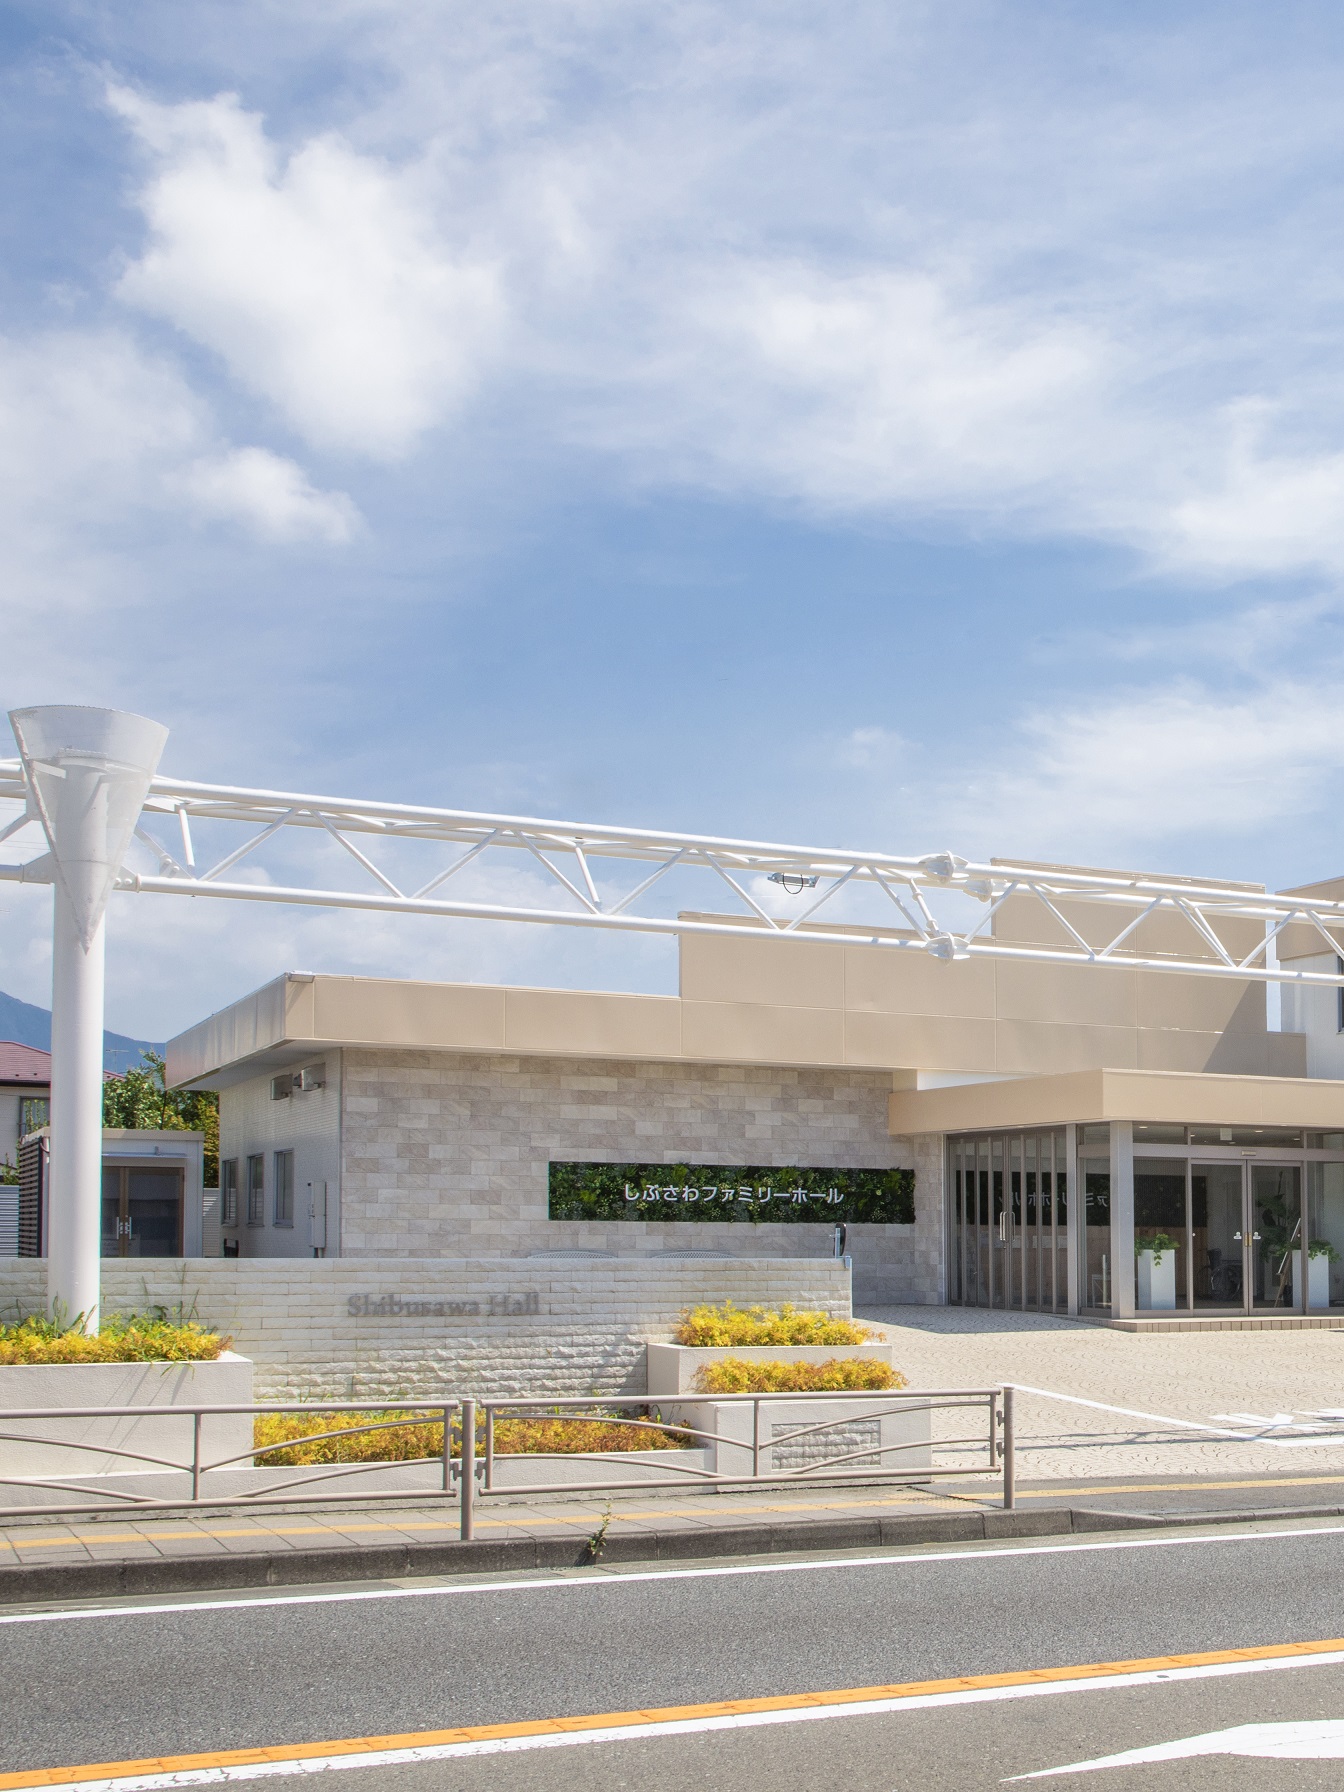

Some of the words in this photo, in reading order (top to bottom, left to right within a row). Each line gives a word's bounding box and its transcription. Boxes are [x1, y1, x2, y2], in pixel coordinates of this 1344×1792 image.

[624, 1183, 845, 1204] しぶさわファミリーホール
[348, 1293, 481, 1316] Shibusawa
[488, 1292, 540, 1316] Hall
